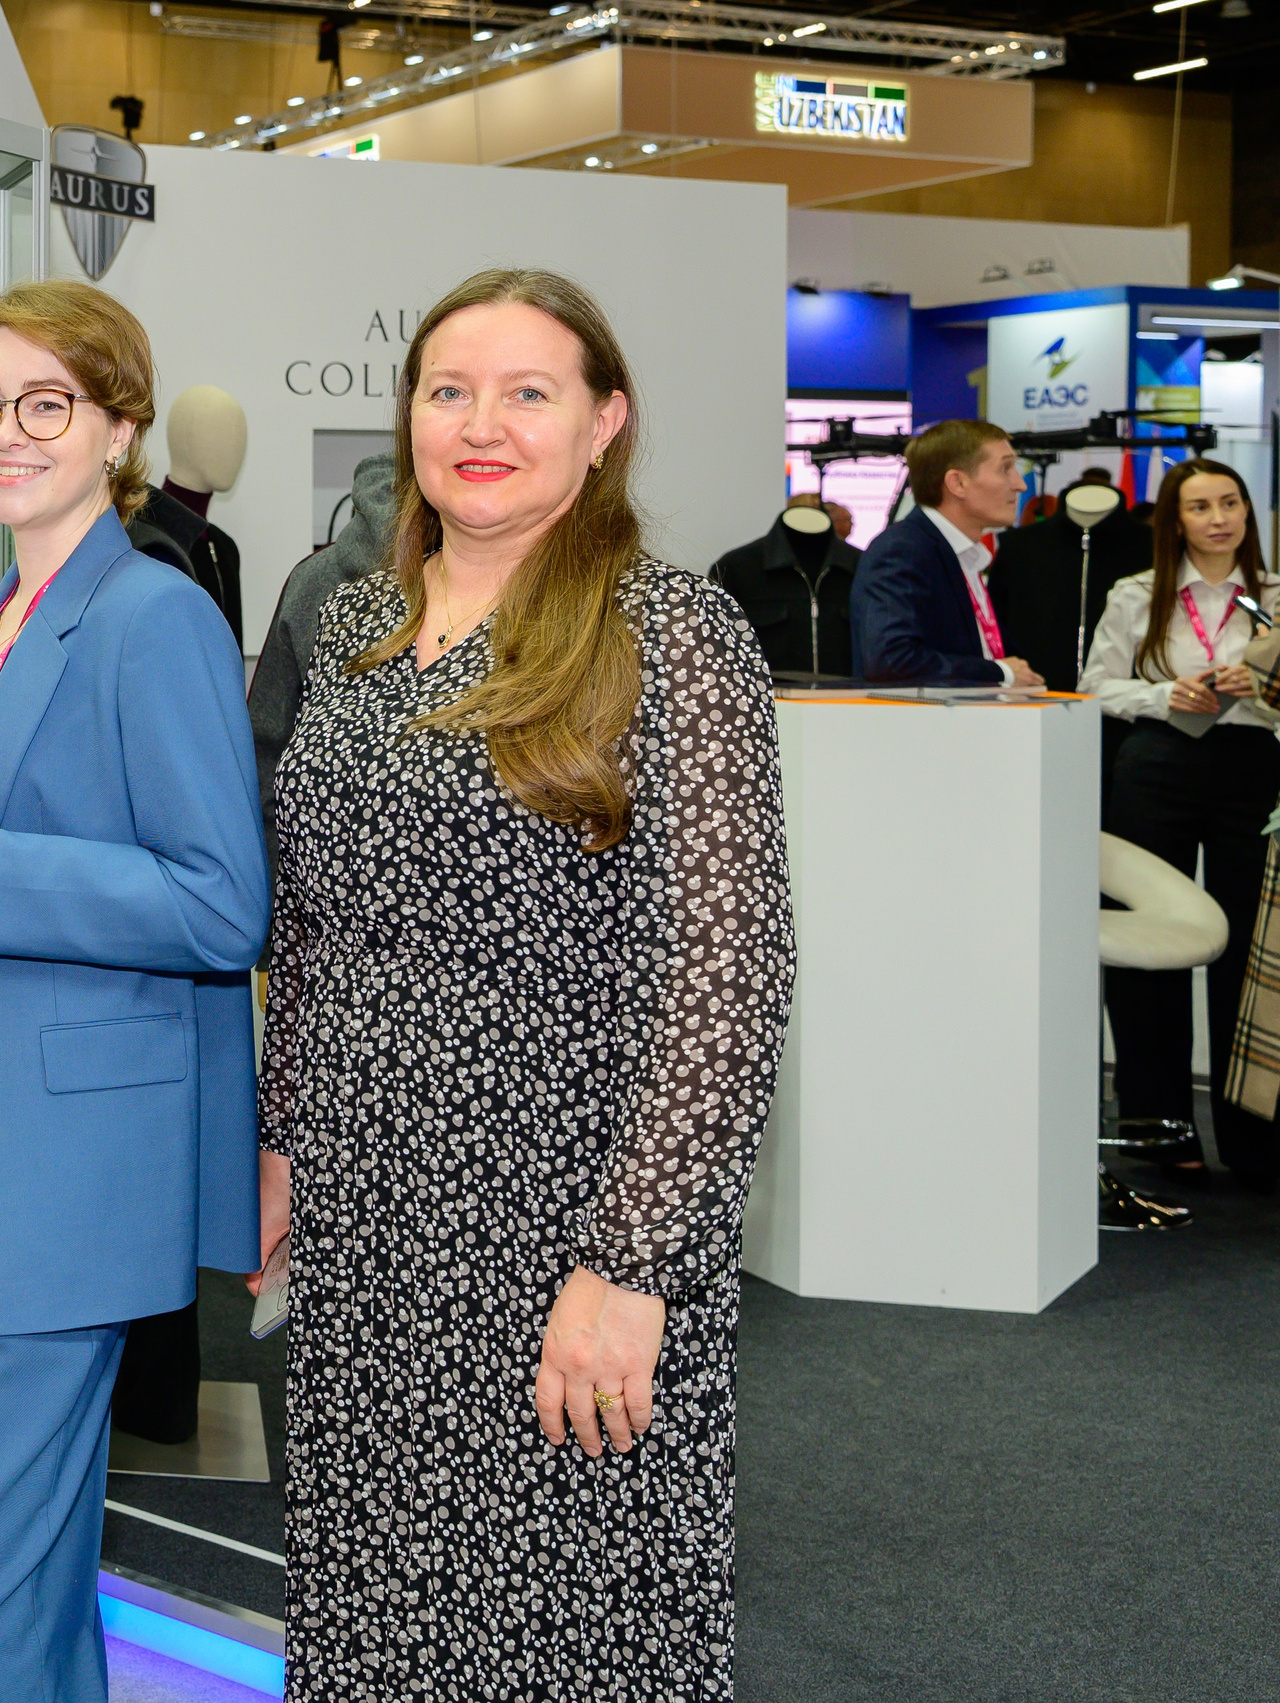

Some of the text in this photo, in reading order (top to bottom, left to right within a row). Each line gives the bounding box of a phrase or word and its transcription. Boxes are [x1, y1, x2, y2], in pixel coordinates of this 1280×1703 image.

[773, 96, 907, 141] UZBEKISTAN
[51, 170, 150, 215] AURUS
[1023, 384, 1089, 410] ЕАЭС
